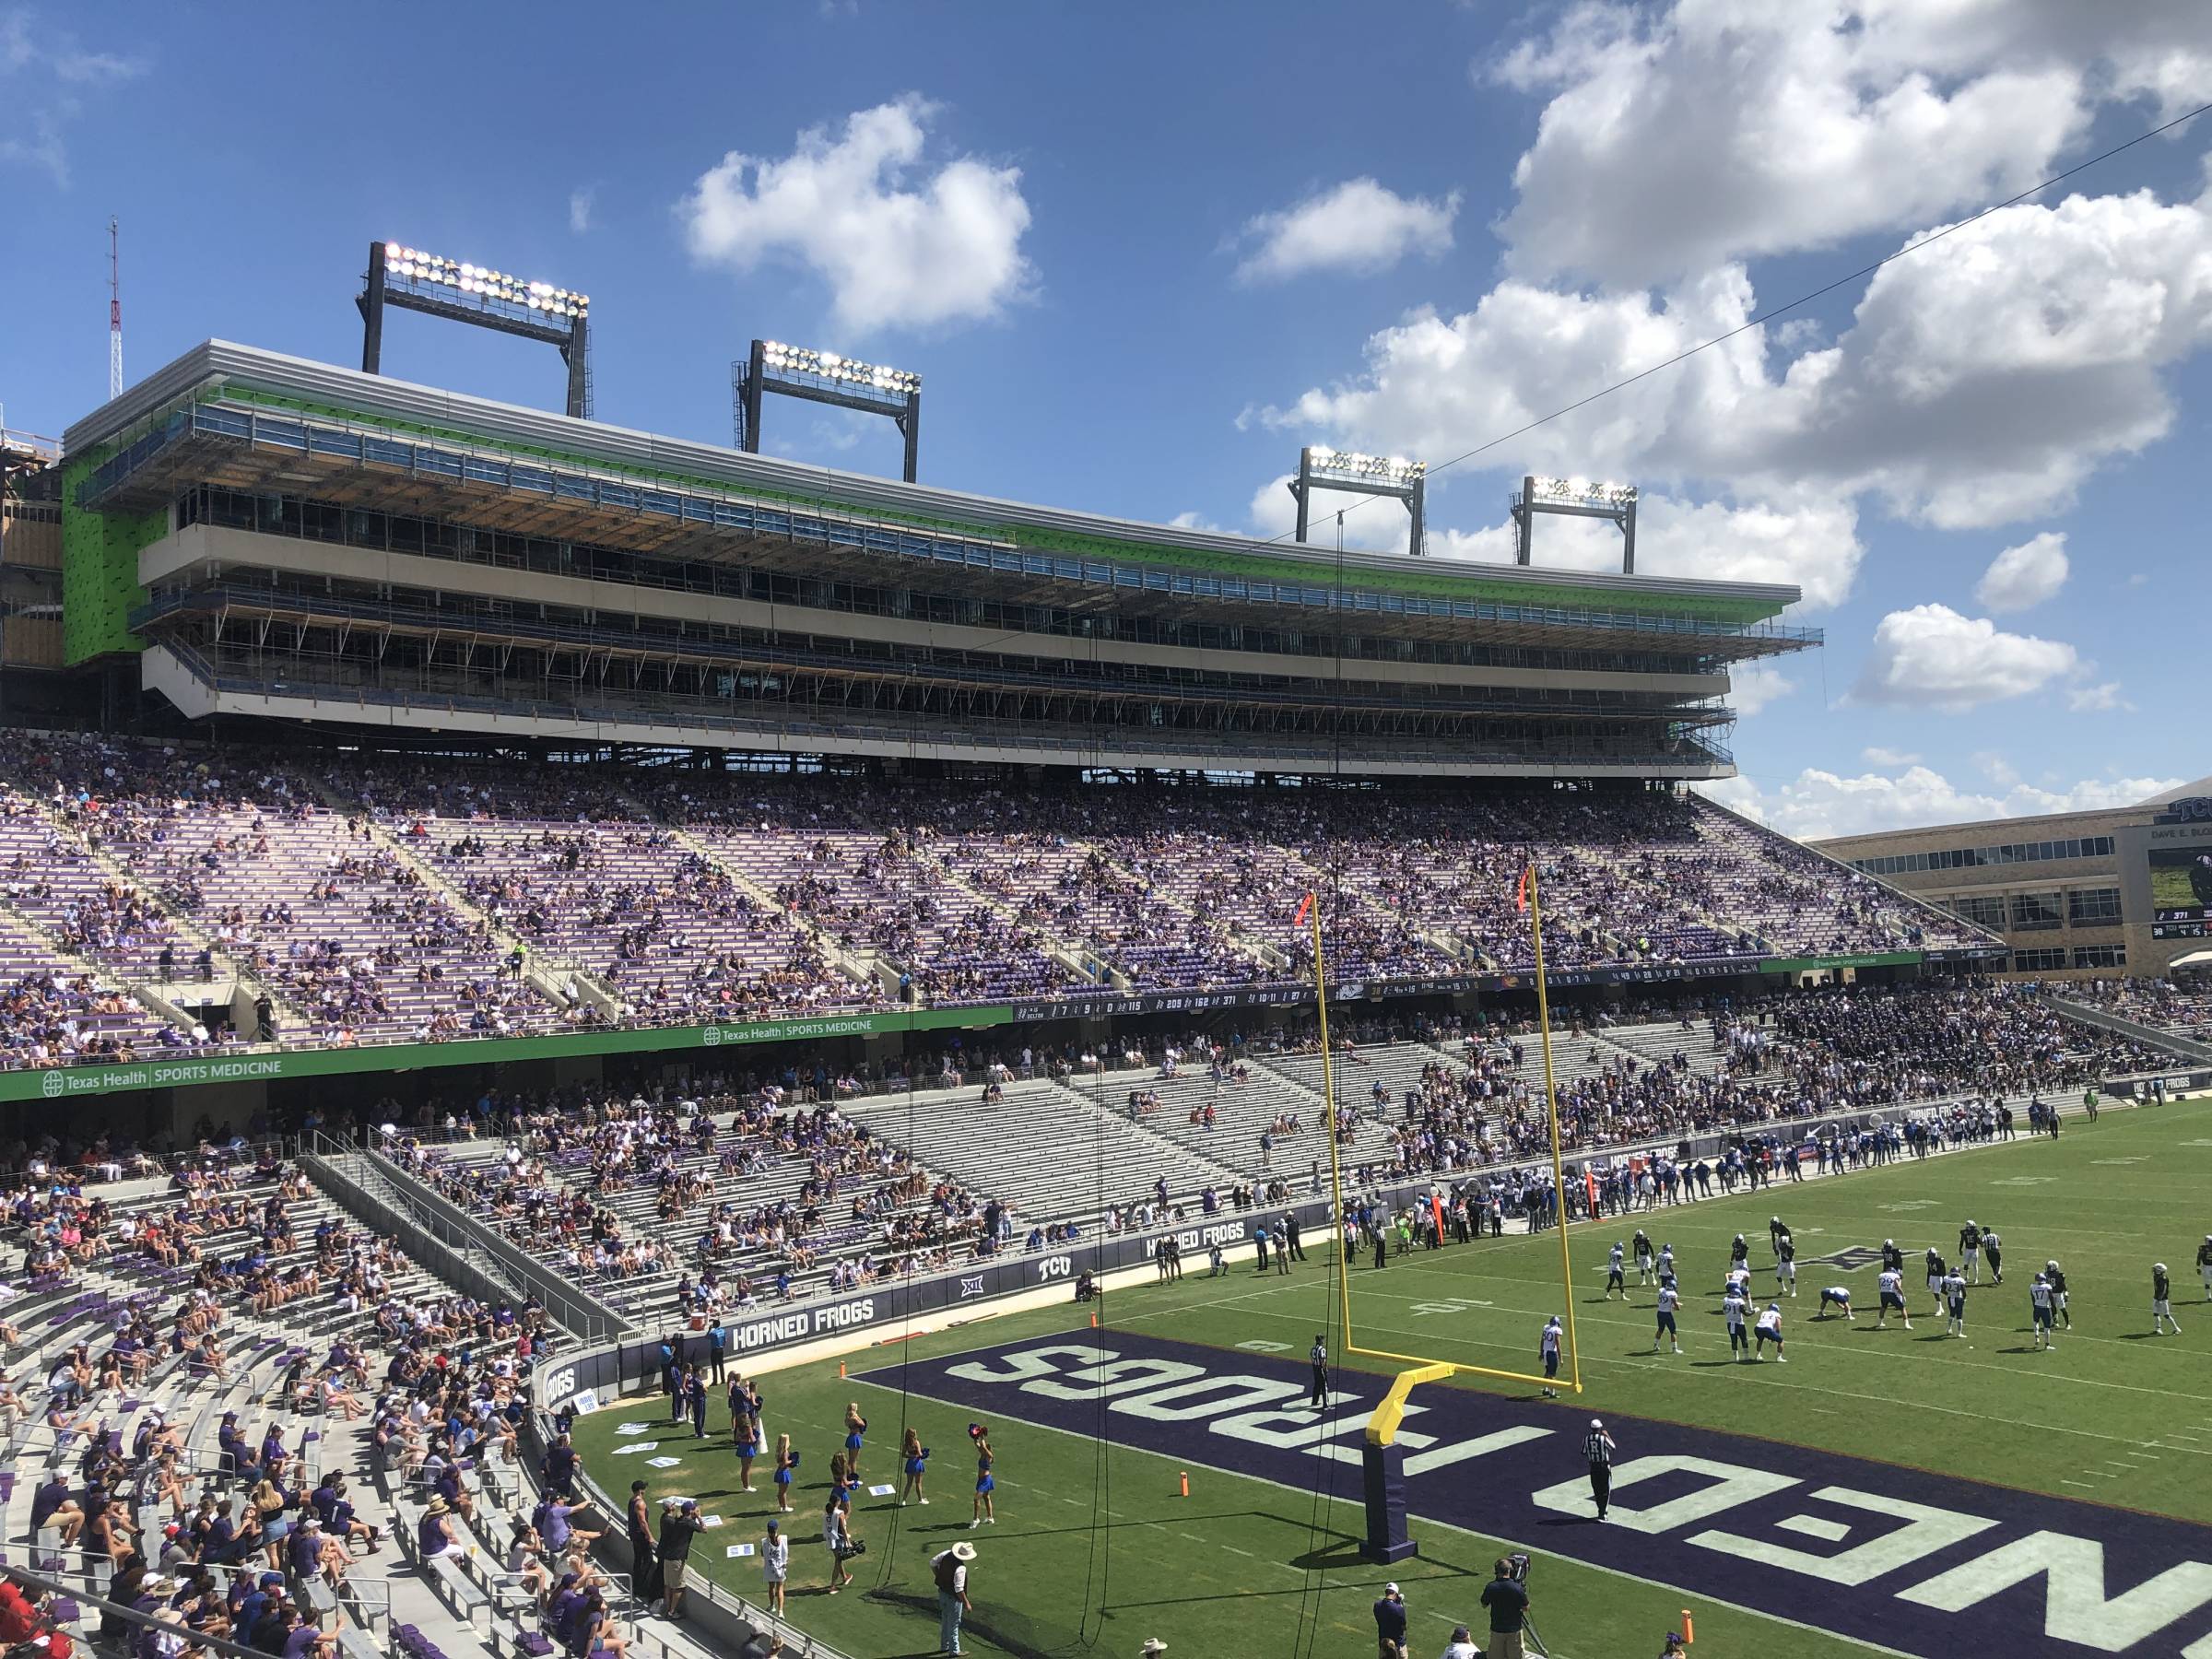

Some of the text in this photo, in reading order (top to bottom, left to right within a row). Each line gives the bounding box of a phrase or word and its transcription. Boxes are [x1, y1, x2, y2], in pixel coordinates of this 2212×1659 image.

[2151, 830, 2175, 839] DAVE
[2173, 912, 2188, 920] 371
[1223, 995, 1236, 1006] 371
[1291, 991, 1300, 1000] 27
[1129, 1001, 1141, 1011] 115
[1166, 998, 1182, 1009] 209
[1194, 997, 1209, 1006] 162
[1062, 1006, 1067, 1015] 7
[1084, 1004, 1090, 1014] 9
[1107, 1003, 1113, 1013] 0
[723, 1019, 872, 1041] Texas Health SPORTS MEDICINE
[66, 1060, 282, 1089] Texas Health SPORTS MEDICINE
[2166, 1077, 2190, 1088] FROGS
[1203, 1221, 1245, 1246] FROGS
[1039, 1256, 1071, 1281] TCU
[733, 1299, 874, 1350] HORNED FROGS
[1591, 1441, 1599, 1453] R
